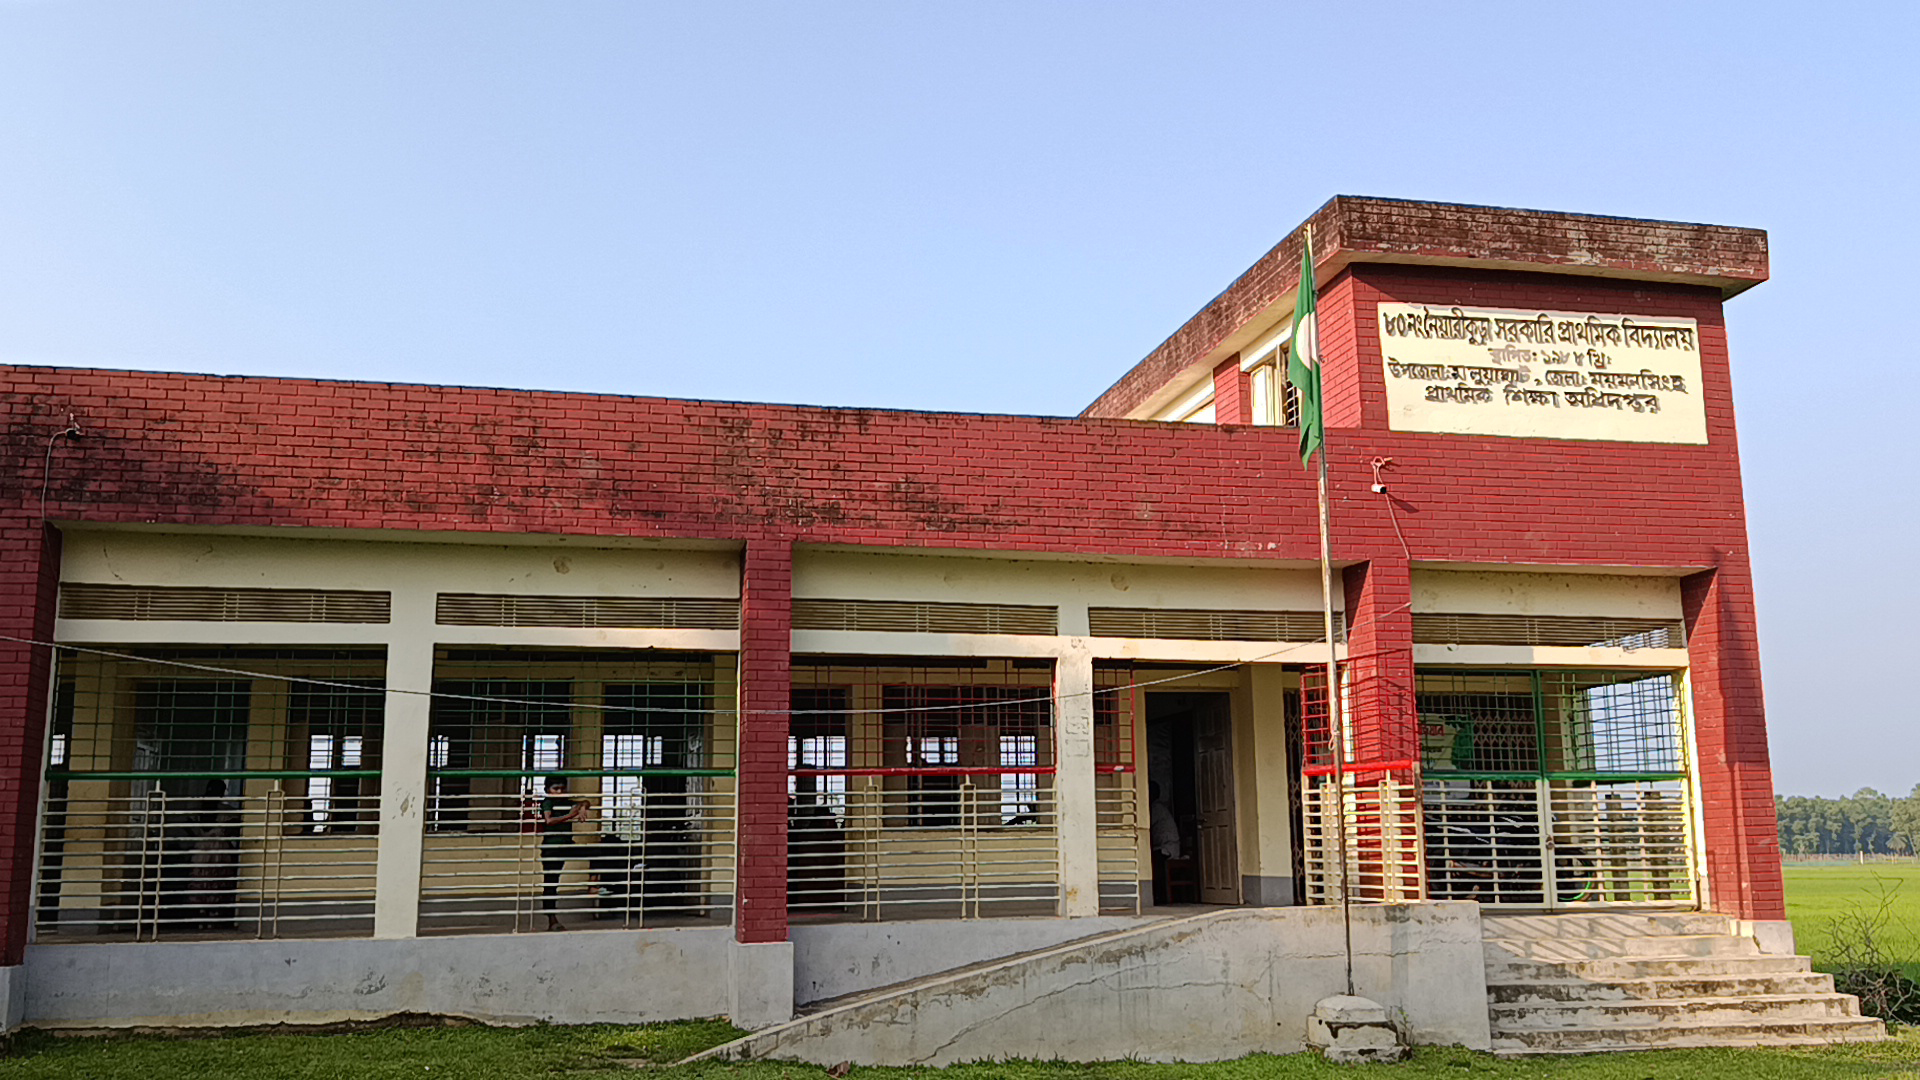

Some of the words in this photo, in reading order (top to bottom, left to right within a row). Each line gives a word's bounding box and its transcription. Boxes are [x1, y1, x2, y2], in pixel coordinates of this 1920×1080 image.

[1494, 313, 1556, 343] সরকারি
[1558, 315, 1622, 348] প্রাথমিক
[1621, 318, 1695, 351] বিদ্যালয়
[1425, 383, 1493, 404] প্রাথমিক
[1503, 384, 1560, 408] শিক্ষা
